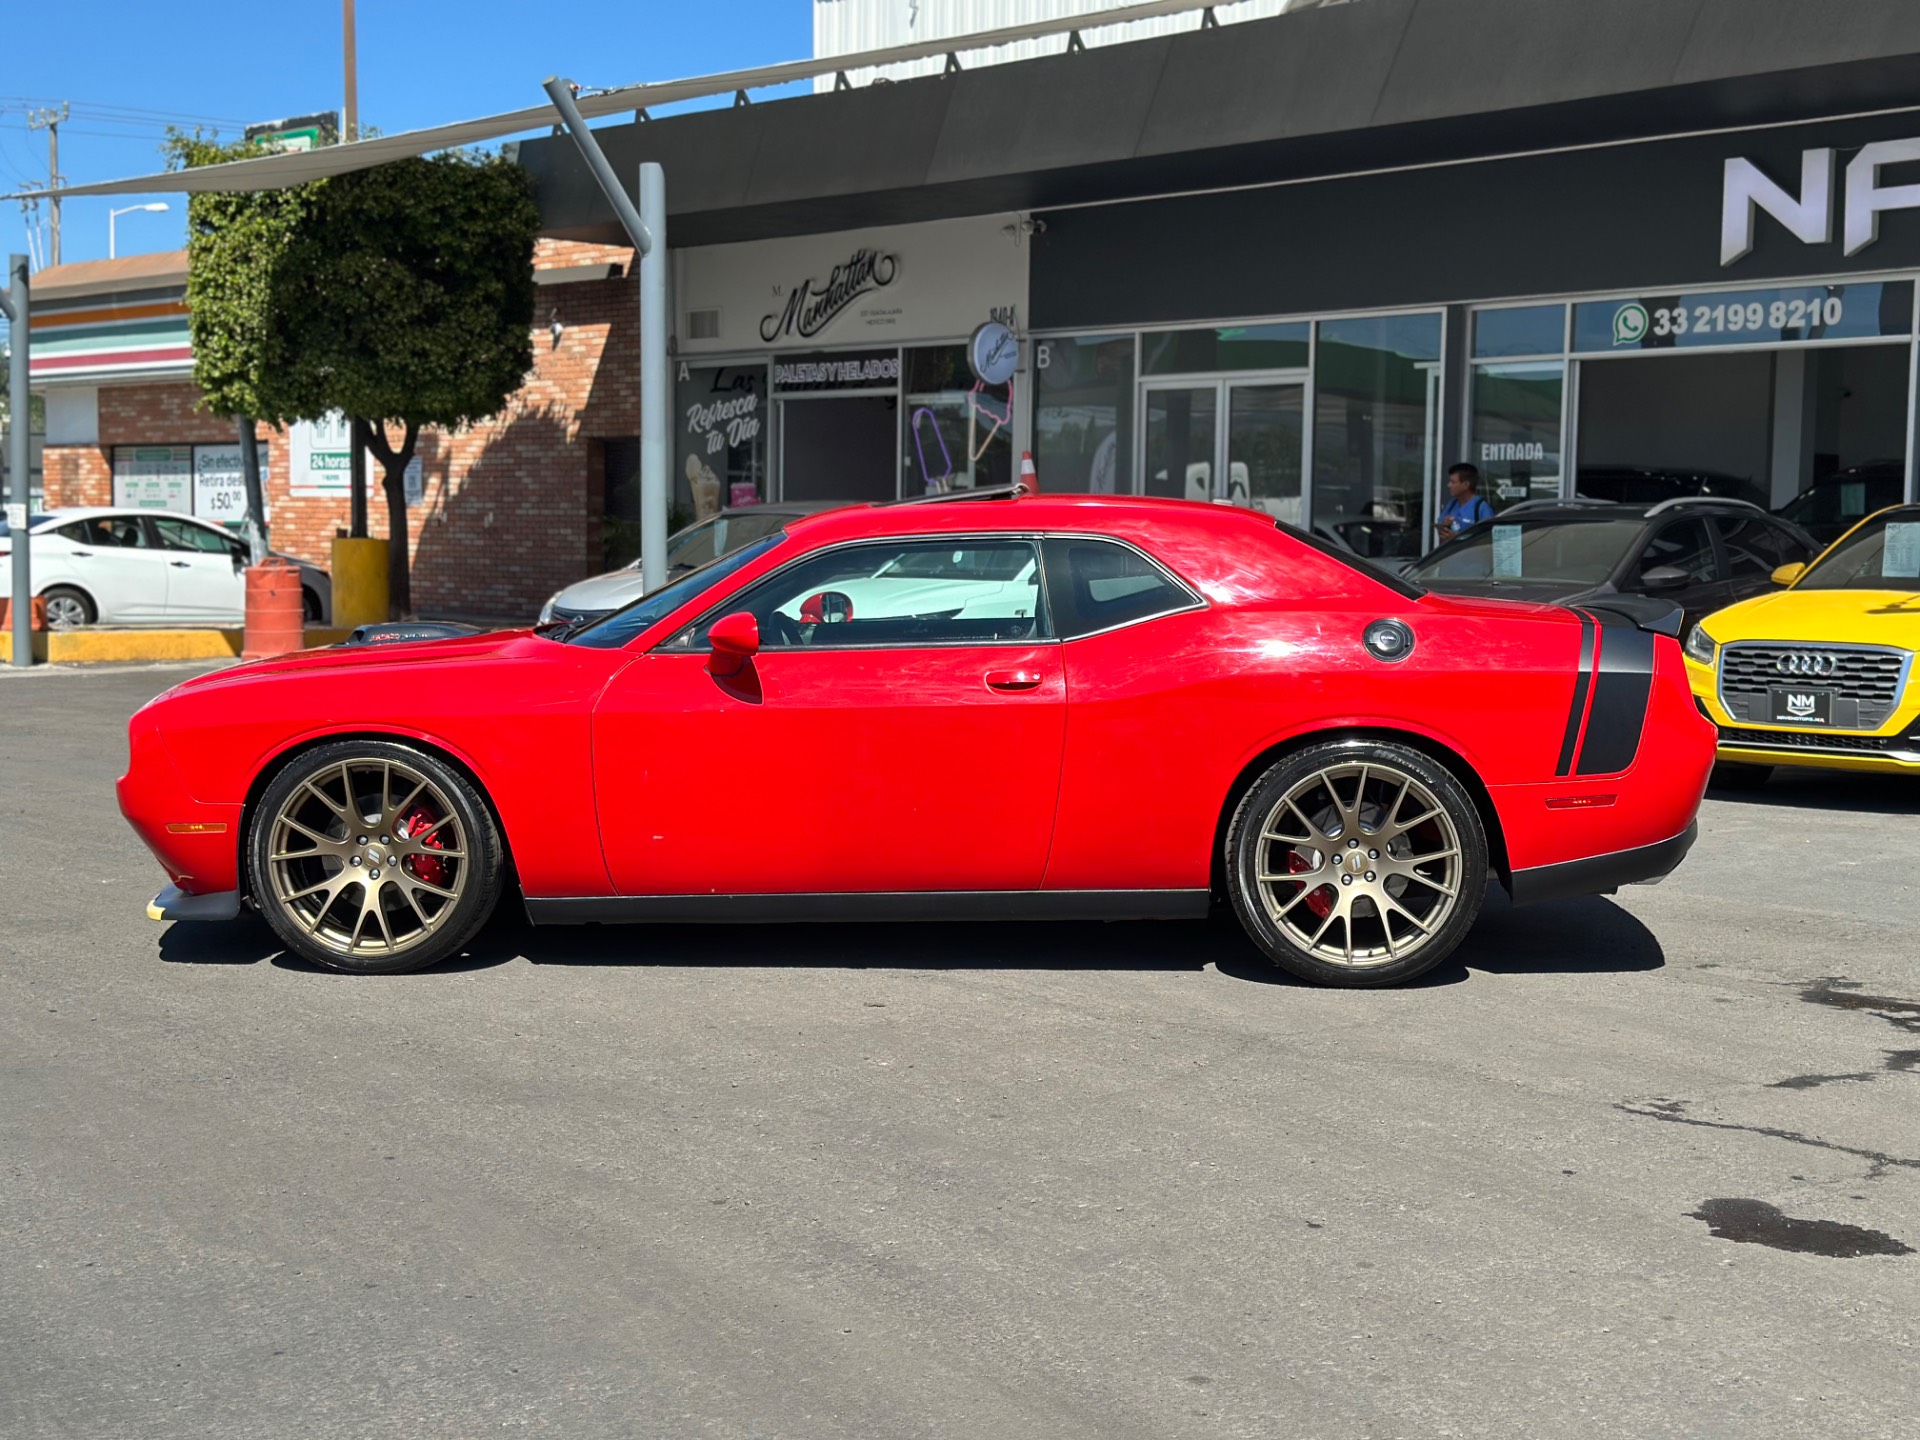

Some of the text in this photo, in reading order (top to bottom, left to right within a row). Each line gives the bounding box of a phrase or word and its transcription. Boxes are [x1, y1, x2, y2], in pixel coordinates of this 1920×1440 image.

[760, 249, 896, 341] Manhattan
[1653, 297, 1842, 336] 33 2199 8210
[1037, 345, 1051, 369] B
[678, 361, 691, 382] A
[774, 358, 900, 384] PALETAS Y HELADOS
[687, 393, 758, 433] Refresca
[706, 430, 725, 454] tu
[1481, 442, 1544, 460] ENTRADA
[311, 453, 351, 469] 24 horas
[1787, 694, 1815, 707] NM
